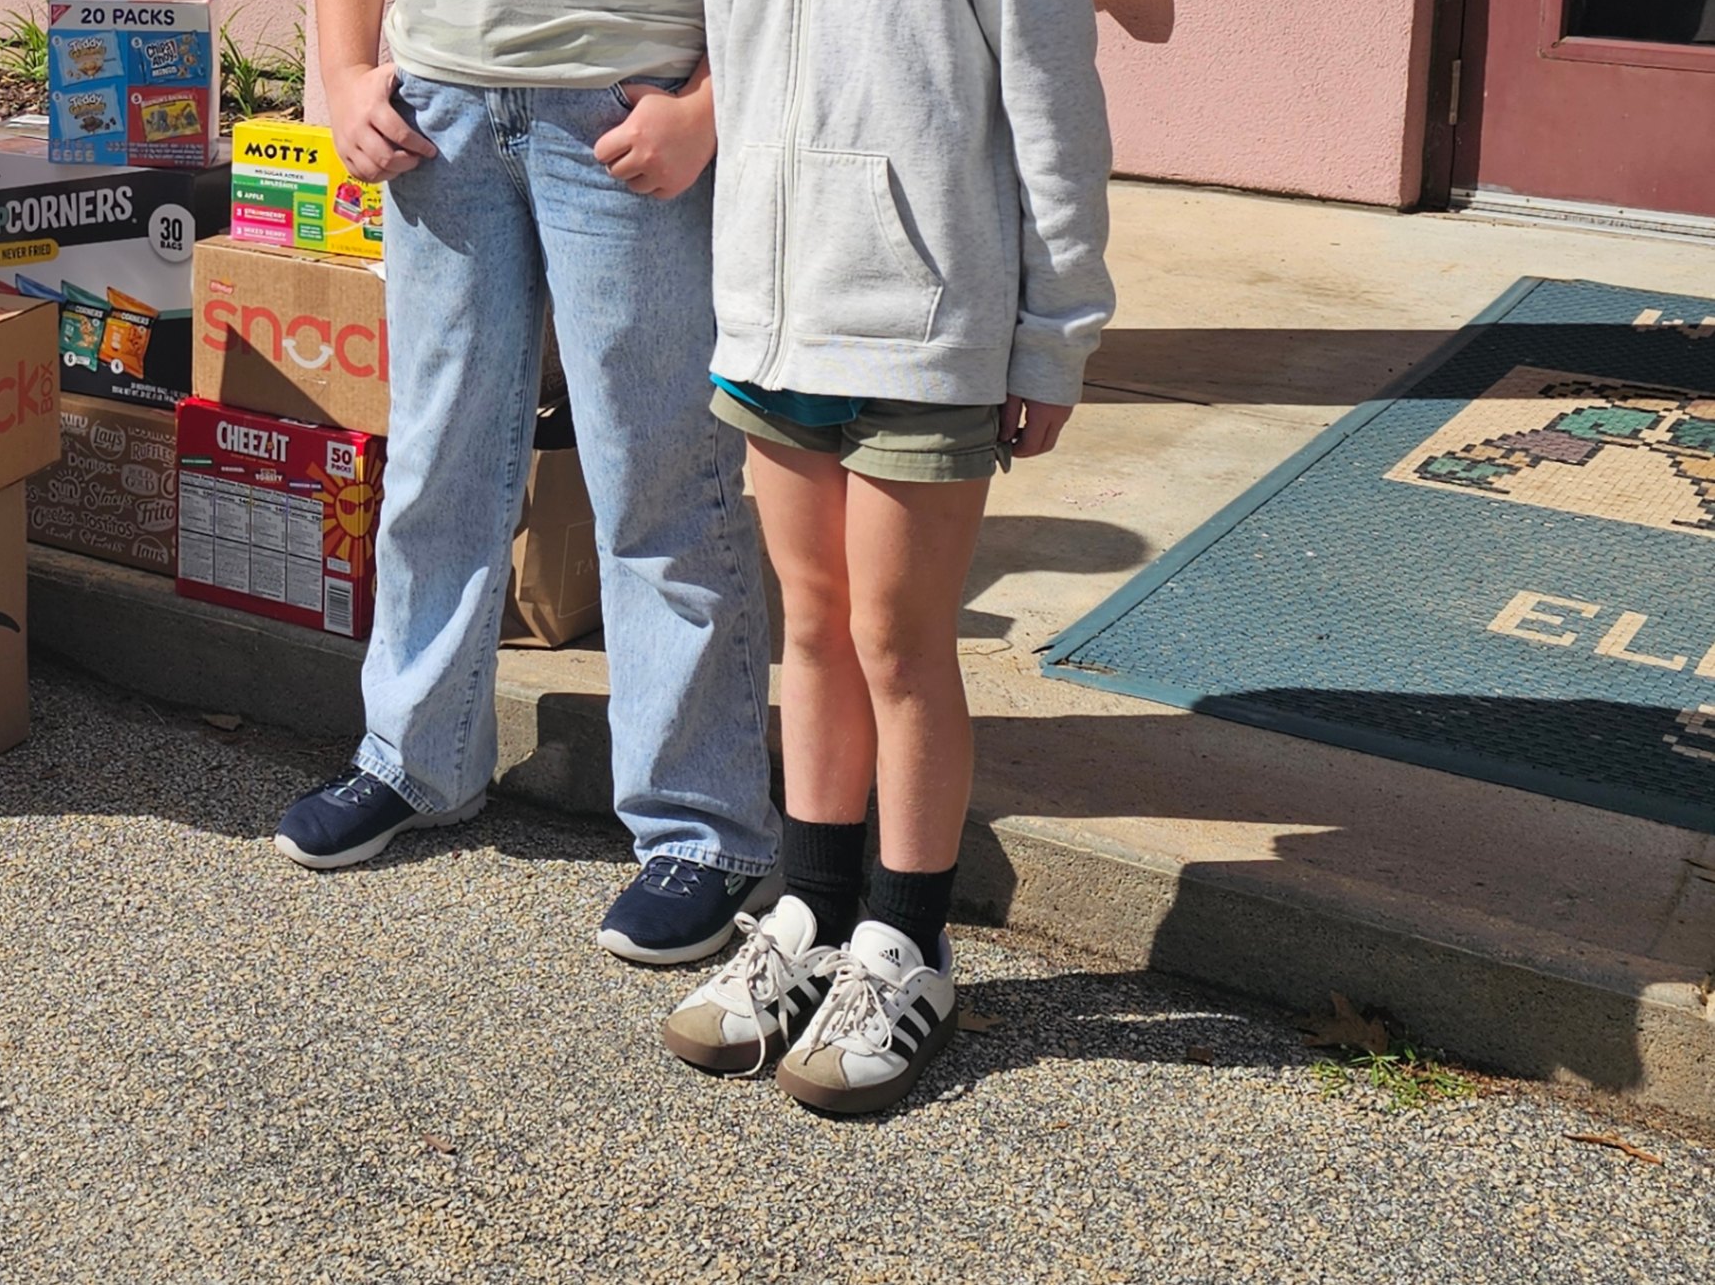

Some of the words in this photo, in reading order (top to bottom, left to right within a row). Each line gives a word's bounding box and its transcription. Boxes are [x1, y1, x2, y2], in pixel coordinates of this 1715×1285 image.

[81, 8, 105, 25] 20
[113, 8, 175, 26] PACKS
[69, 37, 103, 52] Teddy
[145, 41, 174, 59] Chips
[69, 93, 103, 108] Teddy
[244, 142, 318, 164] MOTT'S
[244, 192, 264, 201] APPLE
[159, 217, 183, 241] 30
[2, 246, 26, 260] NEVER
[28, 243, 51, 257] FRIED
[159, 241, 183, 252] BAGS
[40, 361, 53, 414] BOX
[131, 442, 176, 467] RUFFLES
[331, 447, 353, 465] 50
[330, 464, 352, 474] PACKS
[137, 498, 176, 527] Frito
